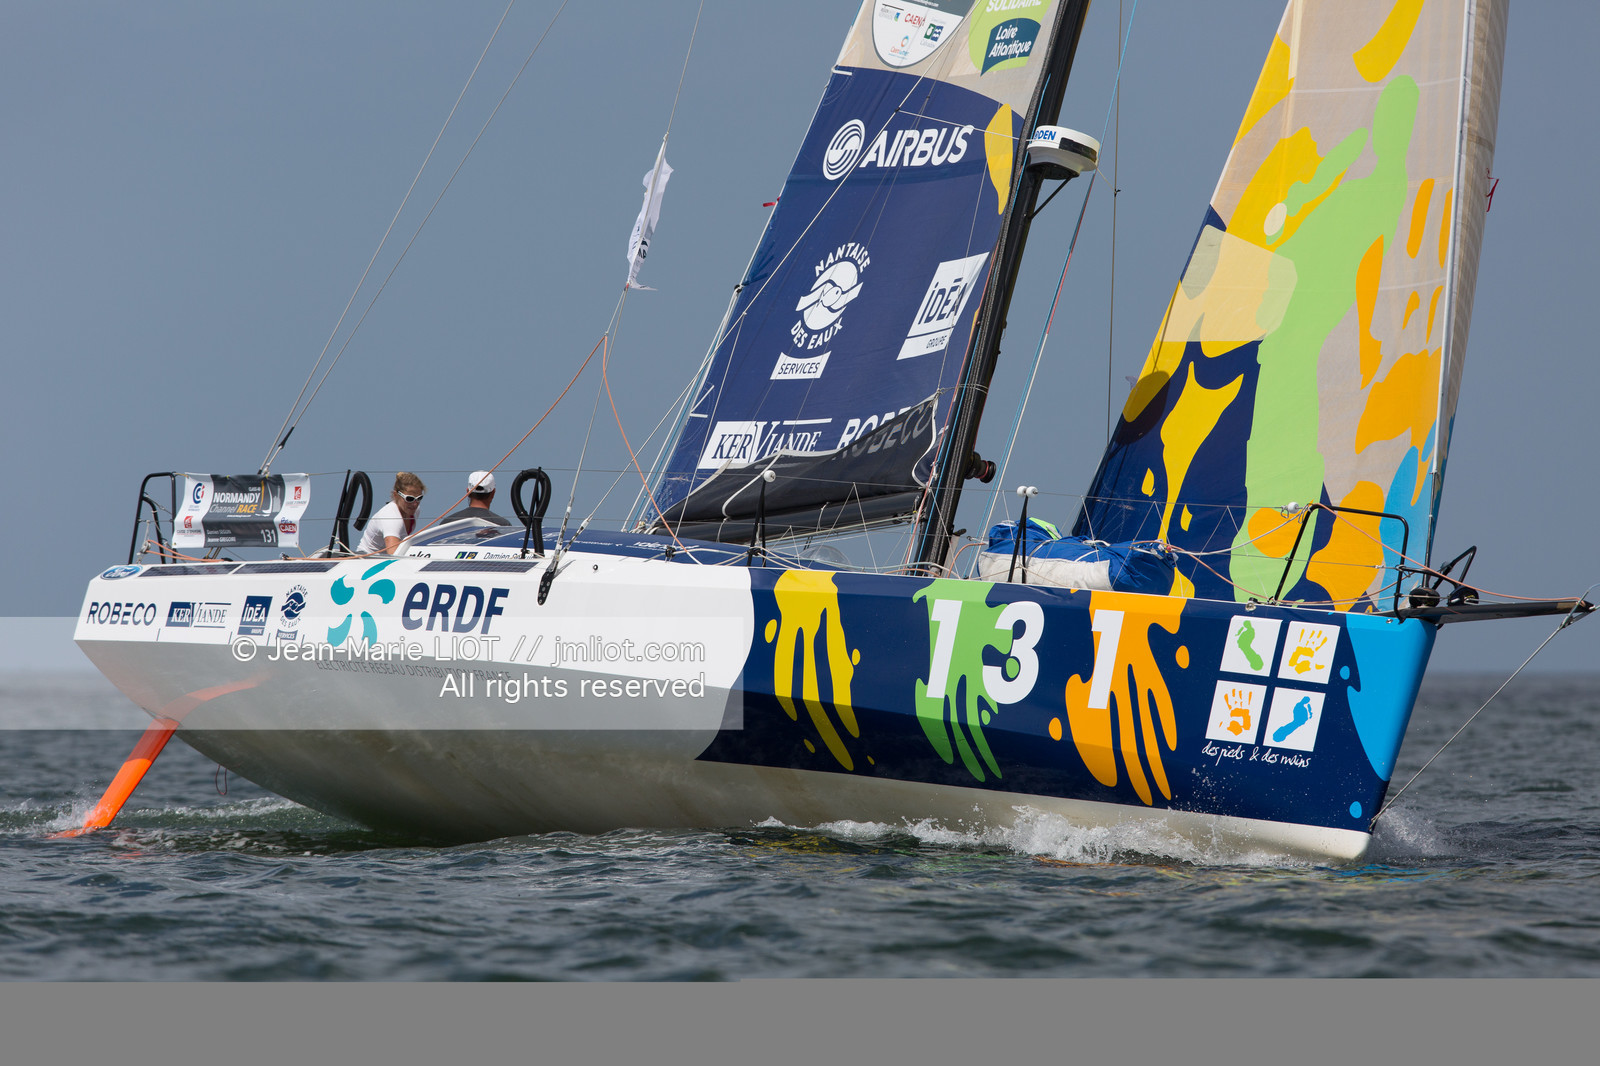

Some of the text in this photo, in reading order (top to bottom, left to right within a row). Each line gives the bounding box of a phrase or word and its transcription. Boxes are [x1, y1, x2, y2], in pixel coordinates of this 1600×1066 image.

[995, 24, 1018, 41] Loire
[988, 40, 1032, 58] Atlantique
[859, 124, 975, 168] AIRBUS
[815, 242, 871, 277] NANTAISE
[790, 316, 843, 350] DES EAUX
[778, 362, 820, 375] SERVICES
[209, 503, 237, 514] Channel
[236, 504, 258, 514] RACE
[213, 492, 260, 504] NORMANDY
[260, 529, 276, 543] 131
[86, 601, 157, 626] ROBECO
[401, 582, 510, 635] eRDF
[1201, 740, 1312, 768] des pieds & des mains
